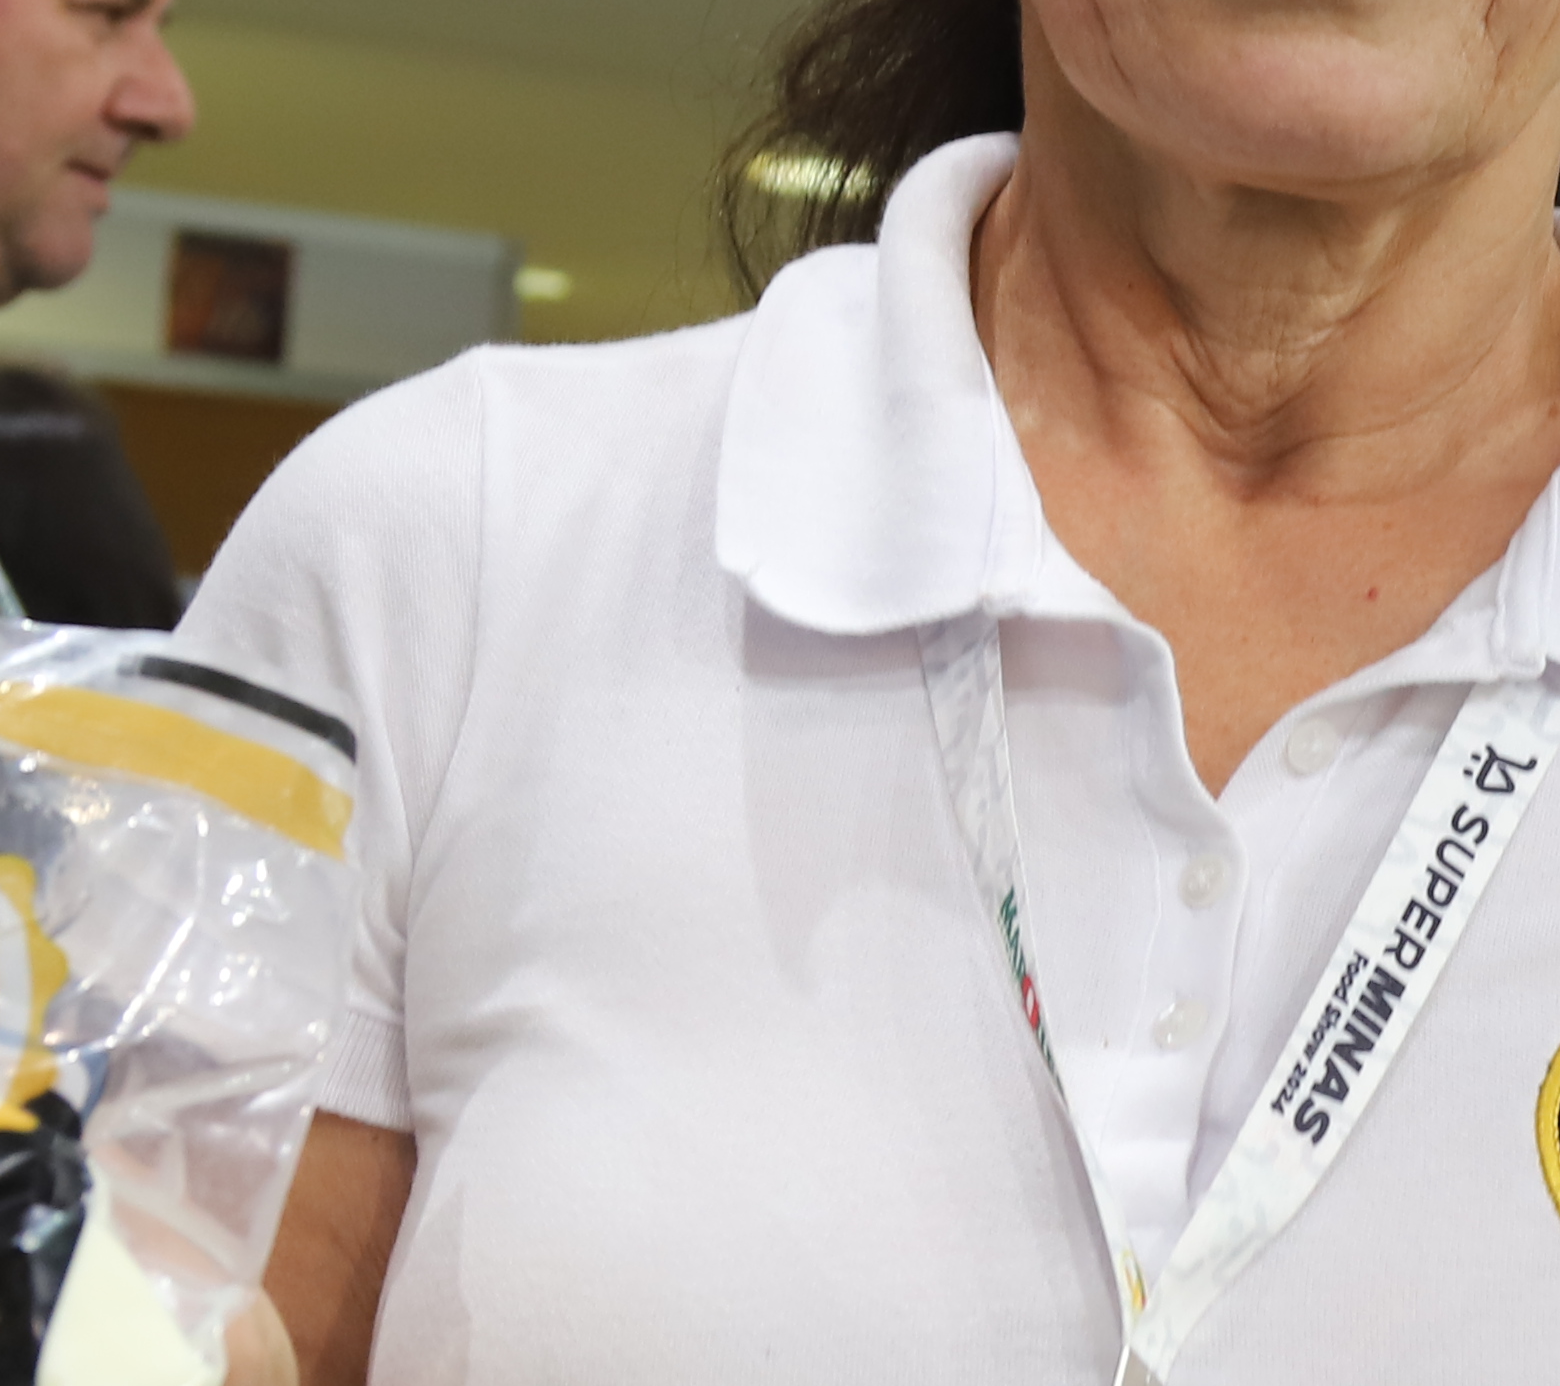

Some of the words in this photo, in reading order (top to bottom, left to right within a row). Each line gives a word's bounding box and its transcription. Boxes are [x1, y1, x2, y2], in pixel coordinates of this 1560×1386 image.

[1339, 949, 1371, 1004] Food
[1304, 1002, 1344, 1061] Show
[1271, 1056, 1307, 1114] 2024
